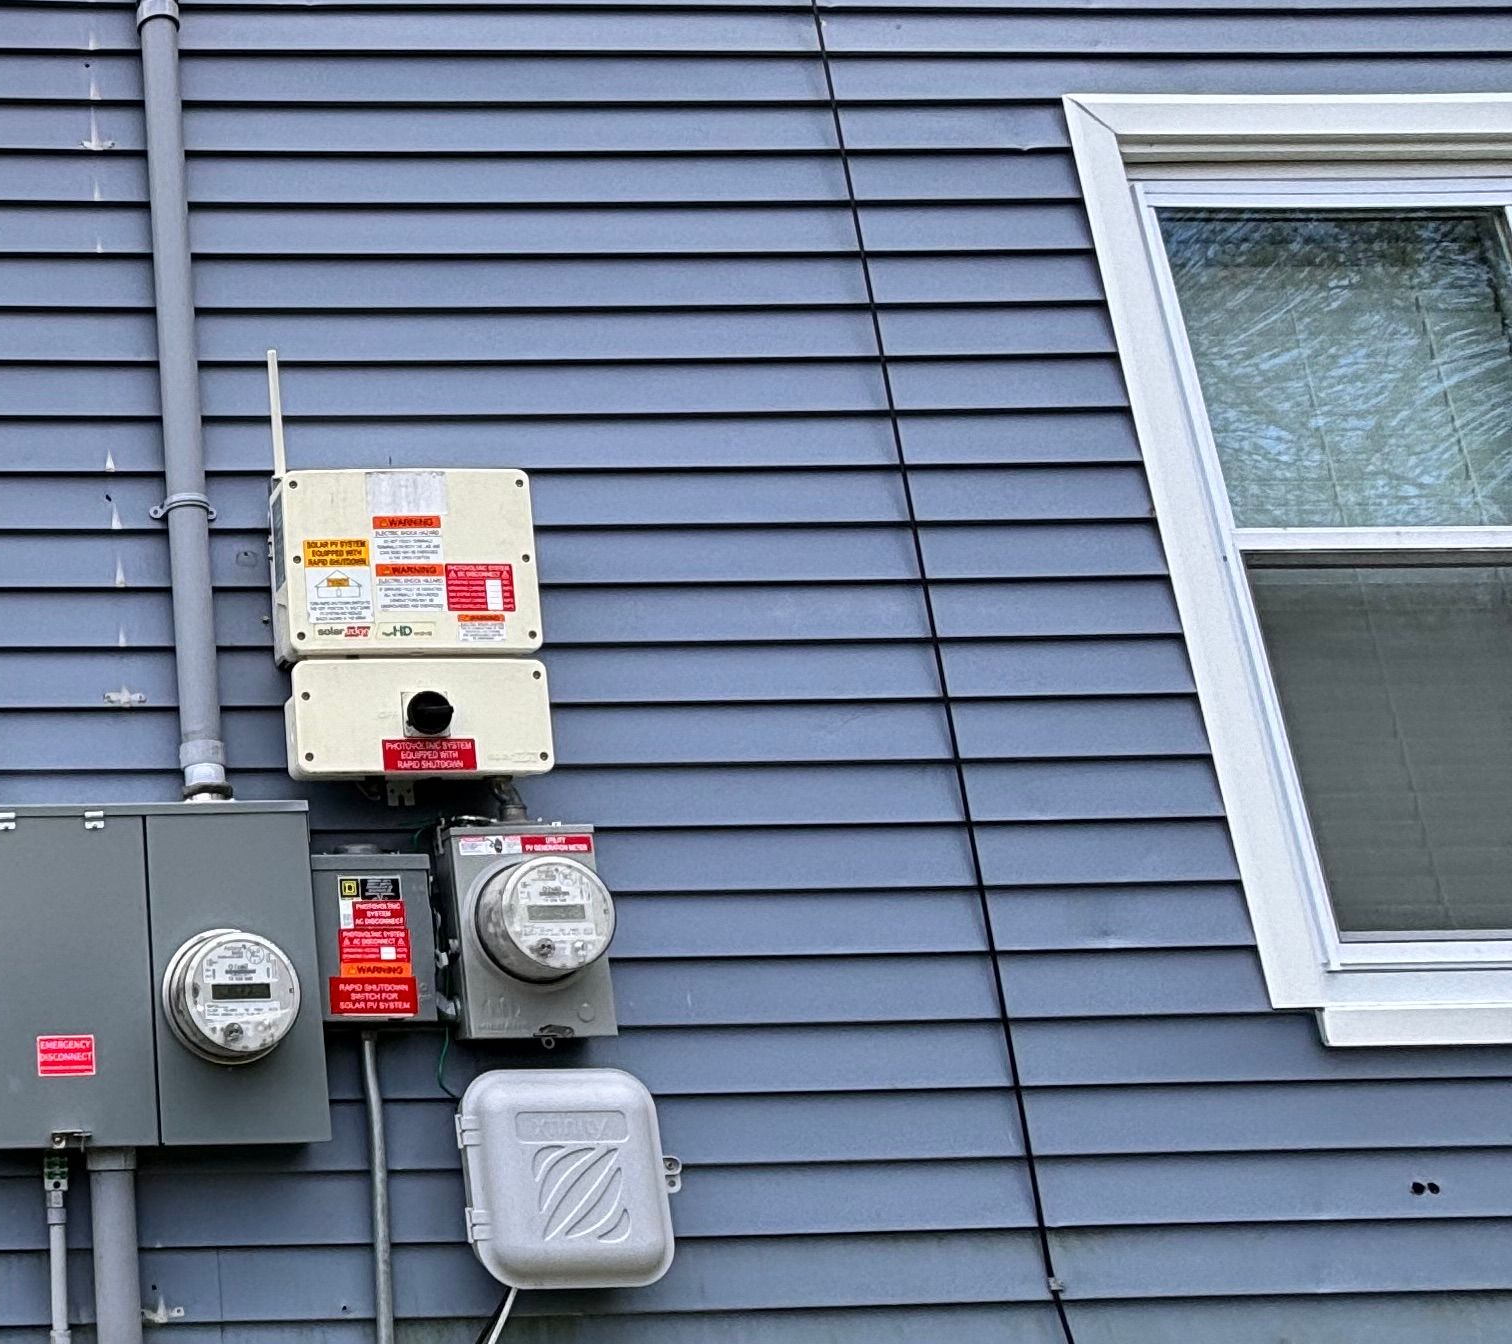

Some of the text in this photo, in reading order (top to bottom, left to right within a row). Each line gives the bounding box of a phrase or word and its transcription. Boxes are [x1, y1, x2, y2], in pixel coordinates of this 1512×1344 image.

[389, 517, 434, 527] WARNING
[307, 541, 329, 549] SOLAR
[339, 540, 366, 548] SYSTEM
[346, 549, 362, 557] WITH
[307, 558, 367, 566] RAPID SHUTDOWN
[392, 566, 437, 575] WARNING
[392, 625, 413, 637] HD
[386, 742, 472, 750] PHOTOVOLTAIC SYSTEM
[400, 751, 459, 759] EQUIPPED WITH
[397, 760, 464, 769] RAPID SHUTDOWN
[545, 836, 567, 844] UTILITY
[365, 917, 404, 925] DISCONNECT
[356, 966, 404, 975] WARNING
[339, 983, 409, 992] RAPID SHUTDOWN
[350, 992, 398, 1000] SWITCH FOR
[339, 1001, 411, 1010] SOLAR PV SYSTEM
[40, 1040, 91, 1049] EMERGENCY
[40, 1052, 92, 1062] DISCONNECT
